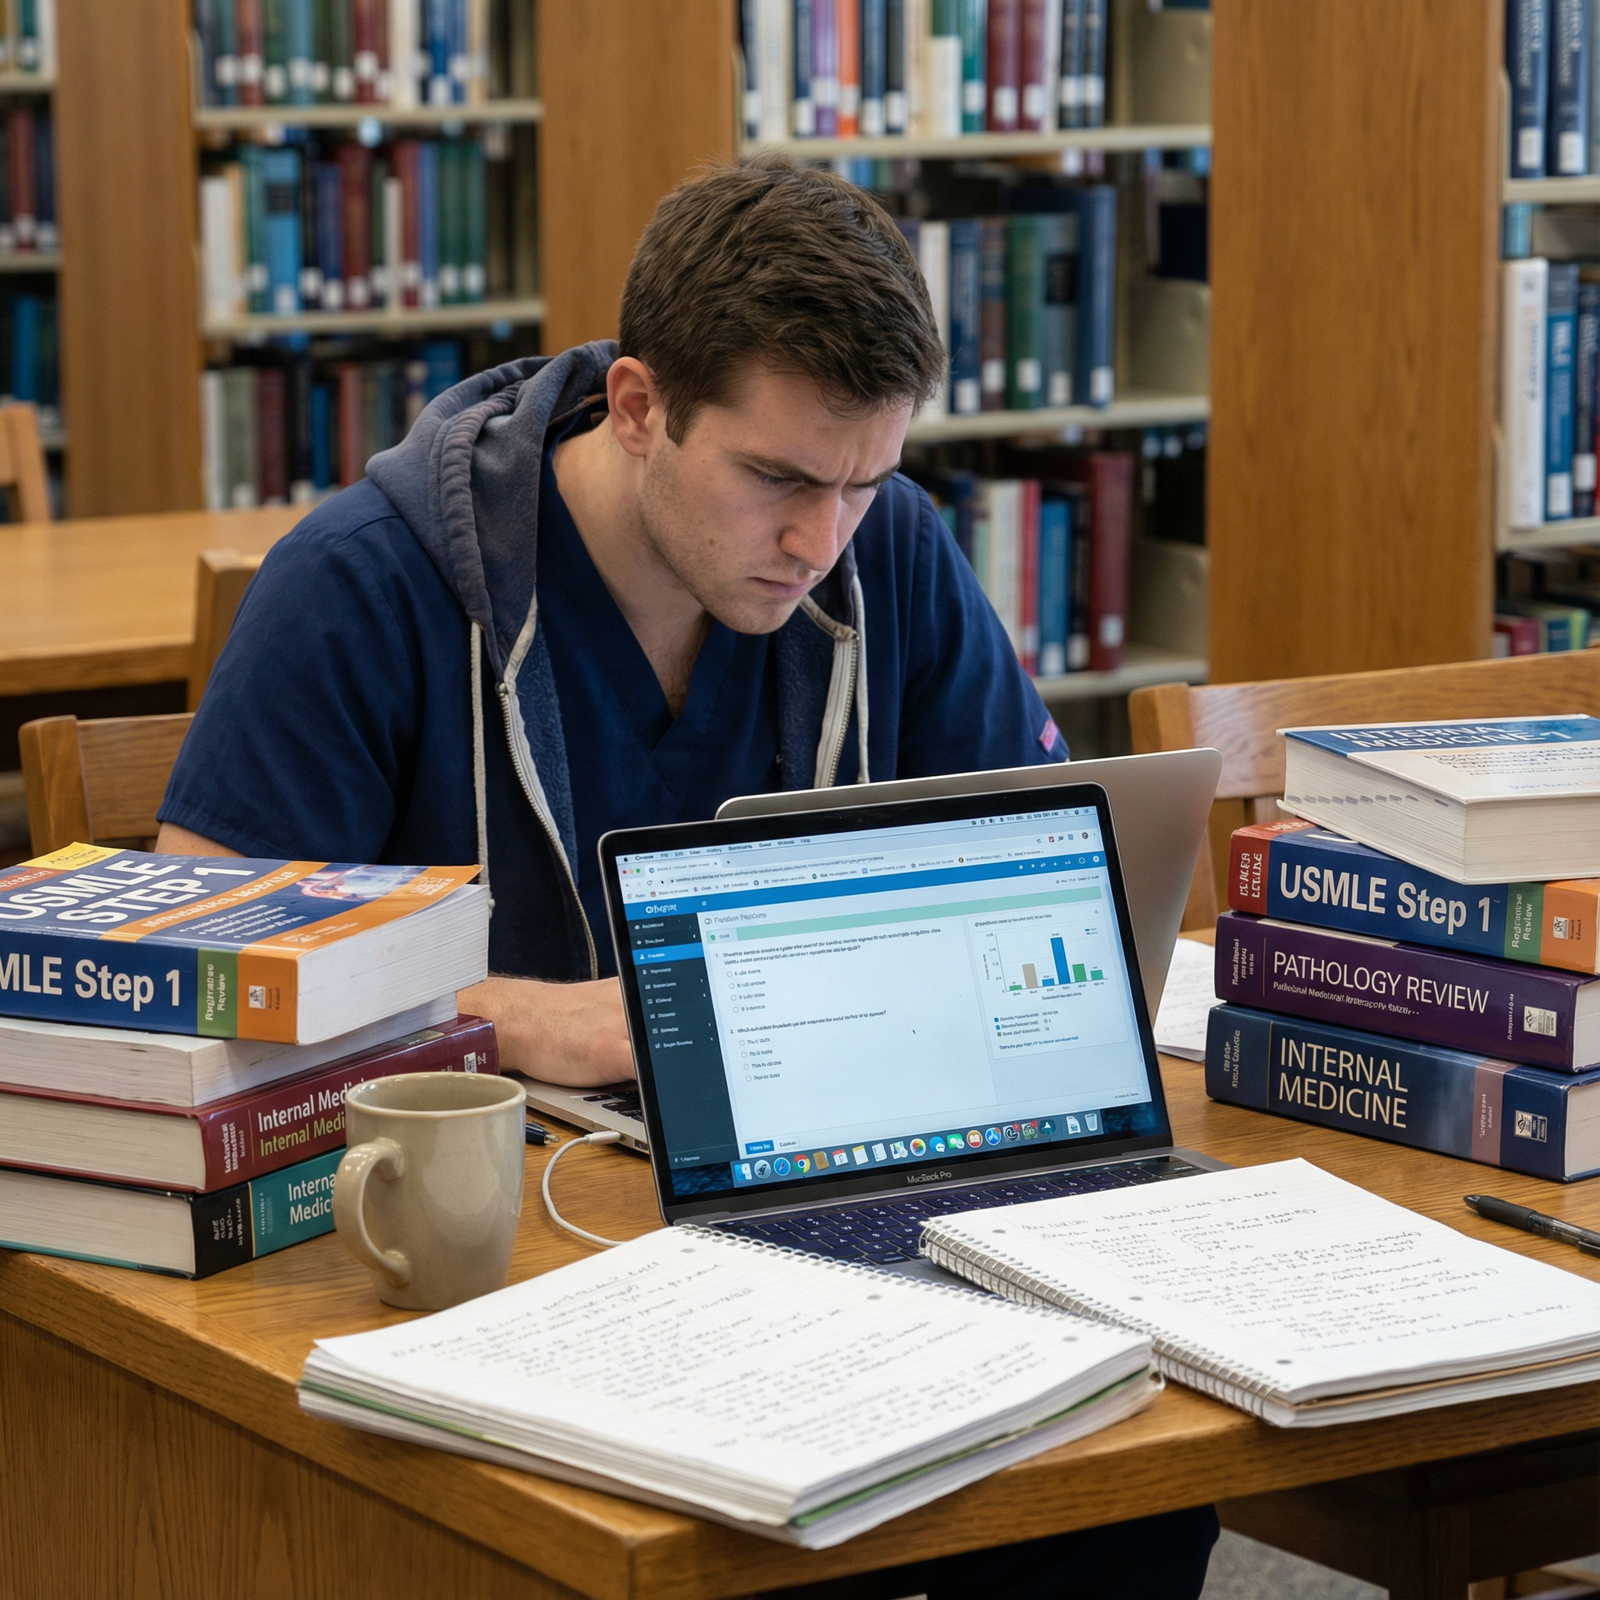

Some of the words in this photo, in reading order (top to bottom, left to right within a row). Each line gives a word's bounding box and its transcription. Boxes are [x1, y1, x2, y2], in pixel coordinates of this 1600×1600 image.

[1352, 732, 1546, 748] MEDICINE
[0, 860, 182, 920] USMLE
[56, 878, 211, 923] STEP
[192, 867, 256, 876] 1
[1280, 862, 1388, 914] USMLE
[1396, 881, 1467, 935] Step
[1478, 897, 1490, 932] 1
[74, 959, 155, 1012] Step
[165, 969, 180, 1007] 1
[1273, 951, 1402, 996] PATHOLOGY
[1405, 975, 1490, 1014] REVIEW
[1279, 1037, 1409, 1093] INTERNAL
[257, 1094, 315, 1133] Internal
[318, 1081, 352, 1112] Med
[1278, 1072, 1408, 1129] MEDICINE
[260, 1122, 310, 1157] Internal
